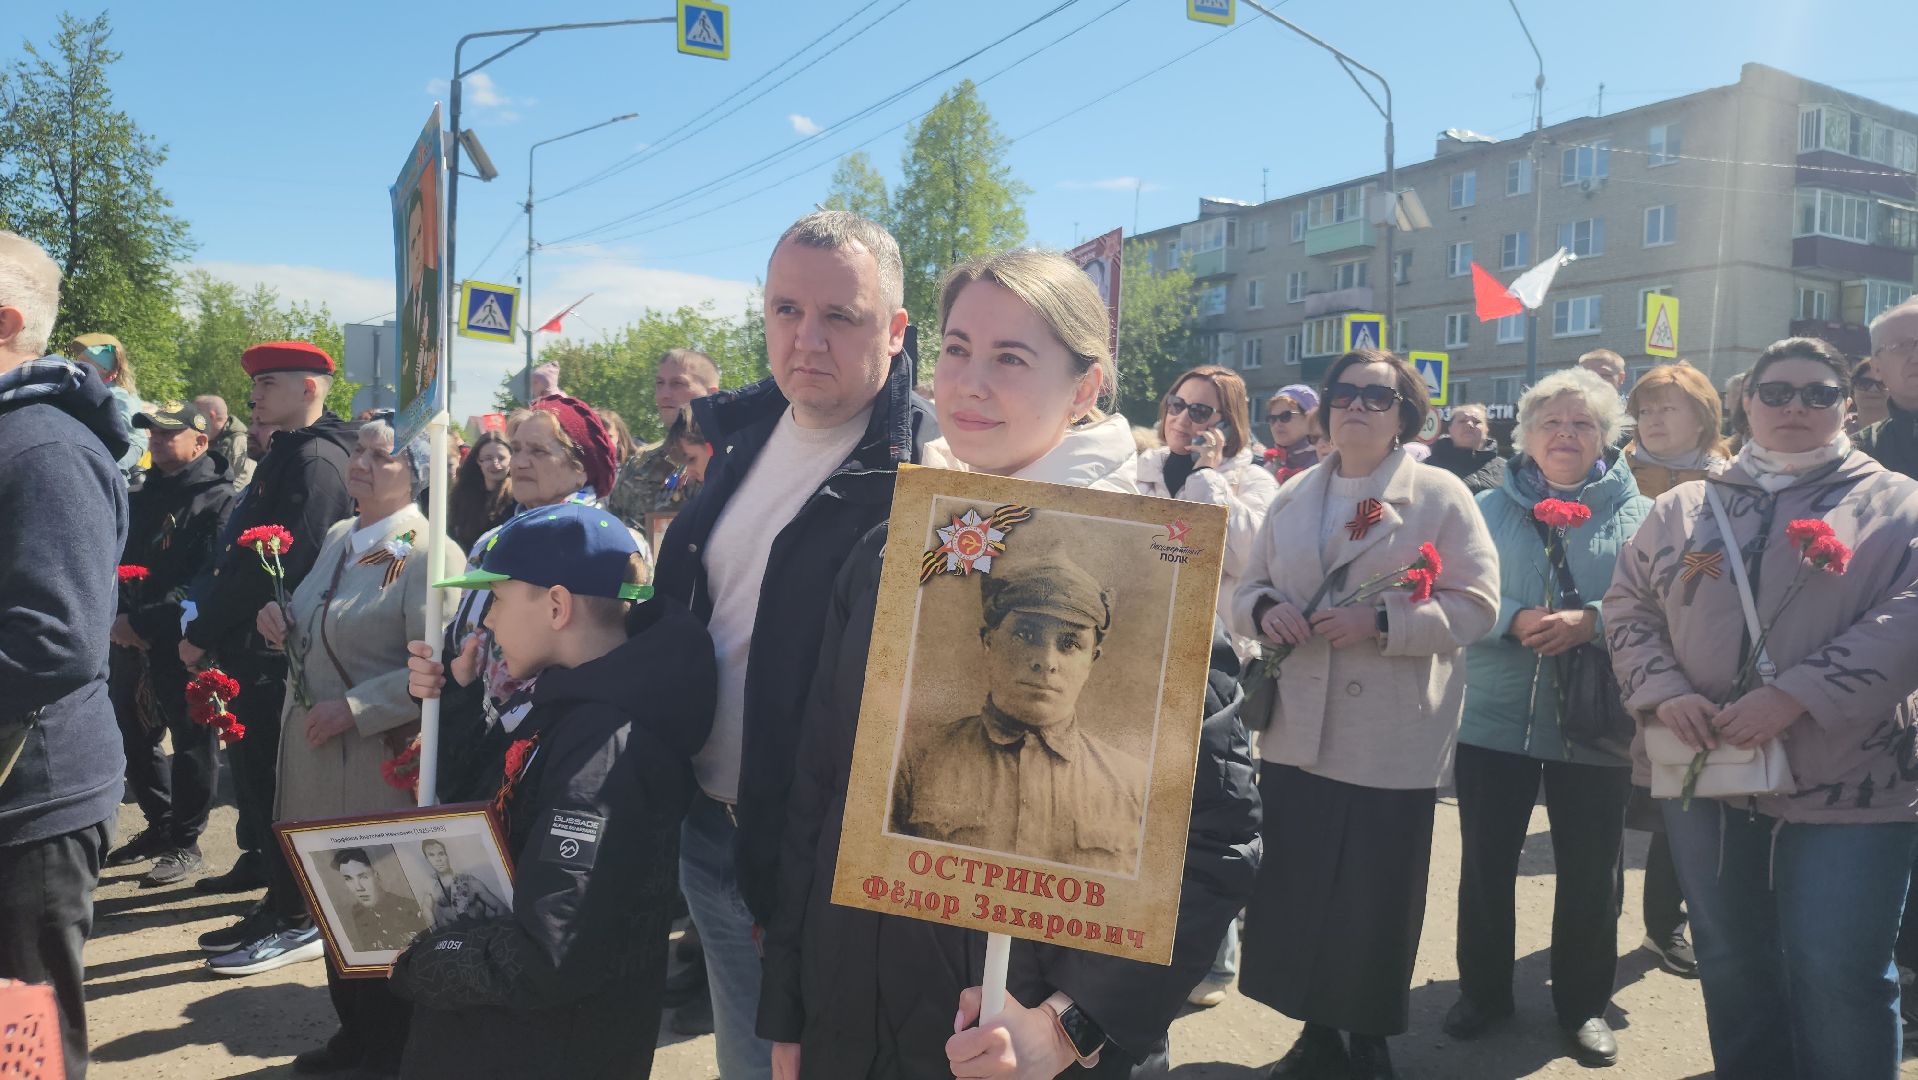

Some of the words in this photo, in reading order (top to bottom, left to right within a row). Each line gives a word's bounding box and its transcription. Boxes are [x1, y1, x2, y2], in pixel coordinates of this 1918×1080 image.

[1159, 552, 1189, 564] ПОЛК
[908, 850, 1106, 907] ОСТРИКОВ
[862, 875, 960, 919] Фёдор
[972, 893, 1146, 949] Захарович
